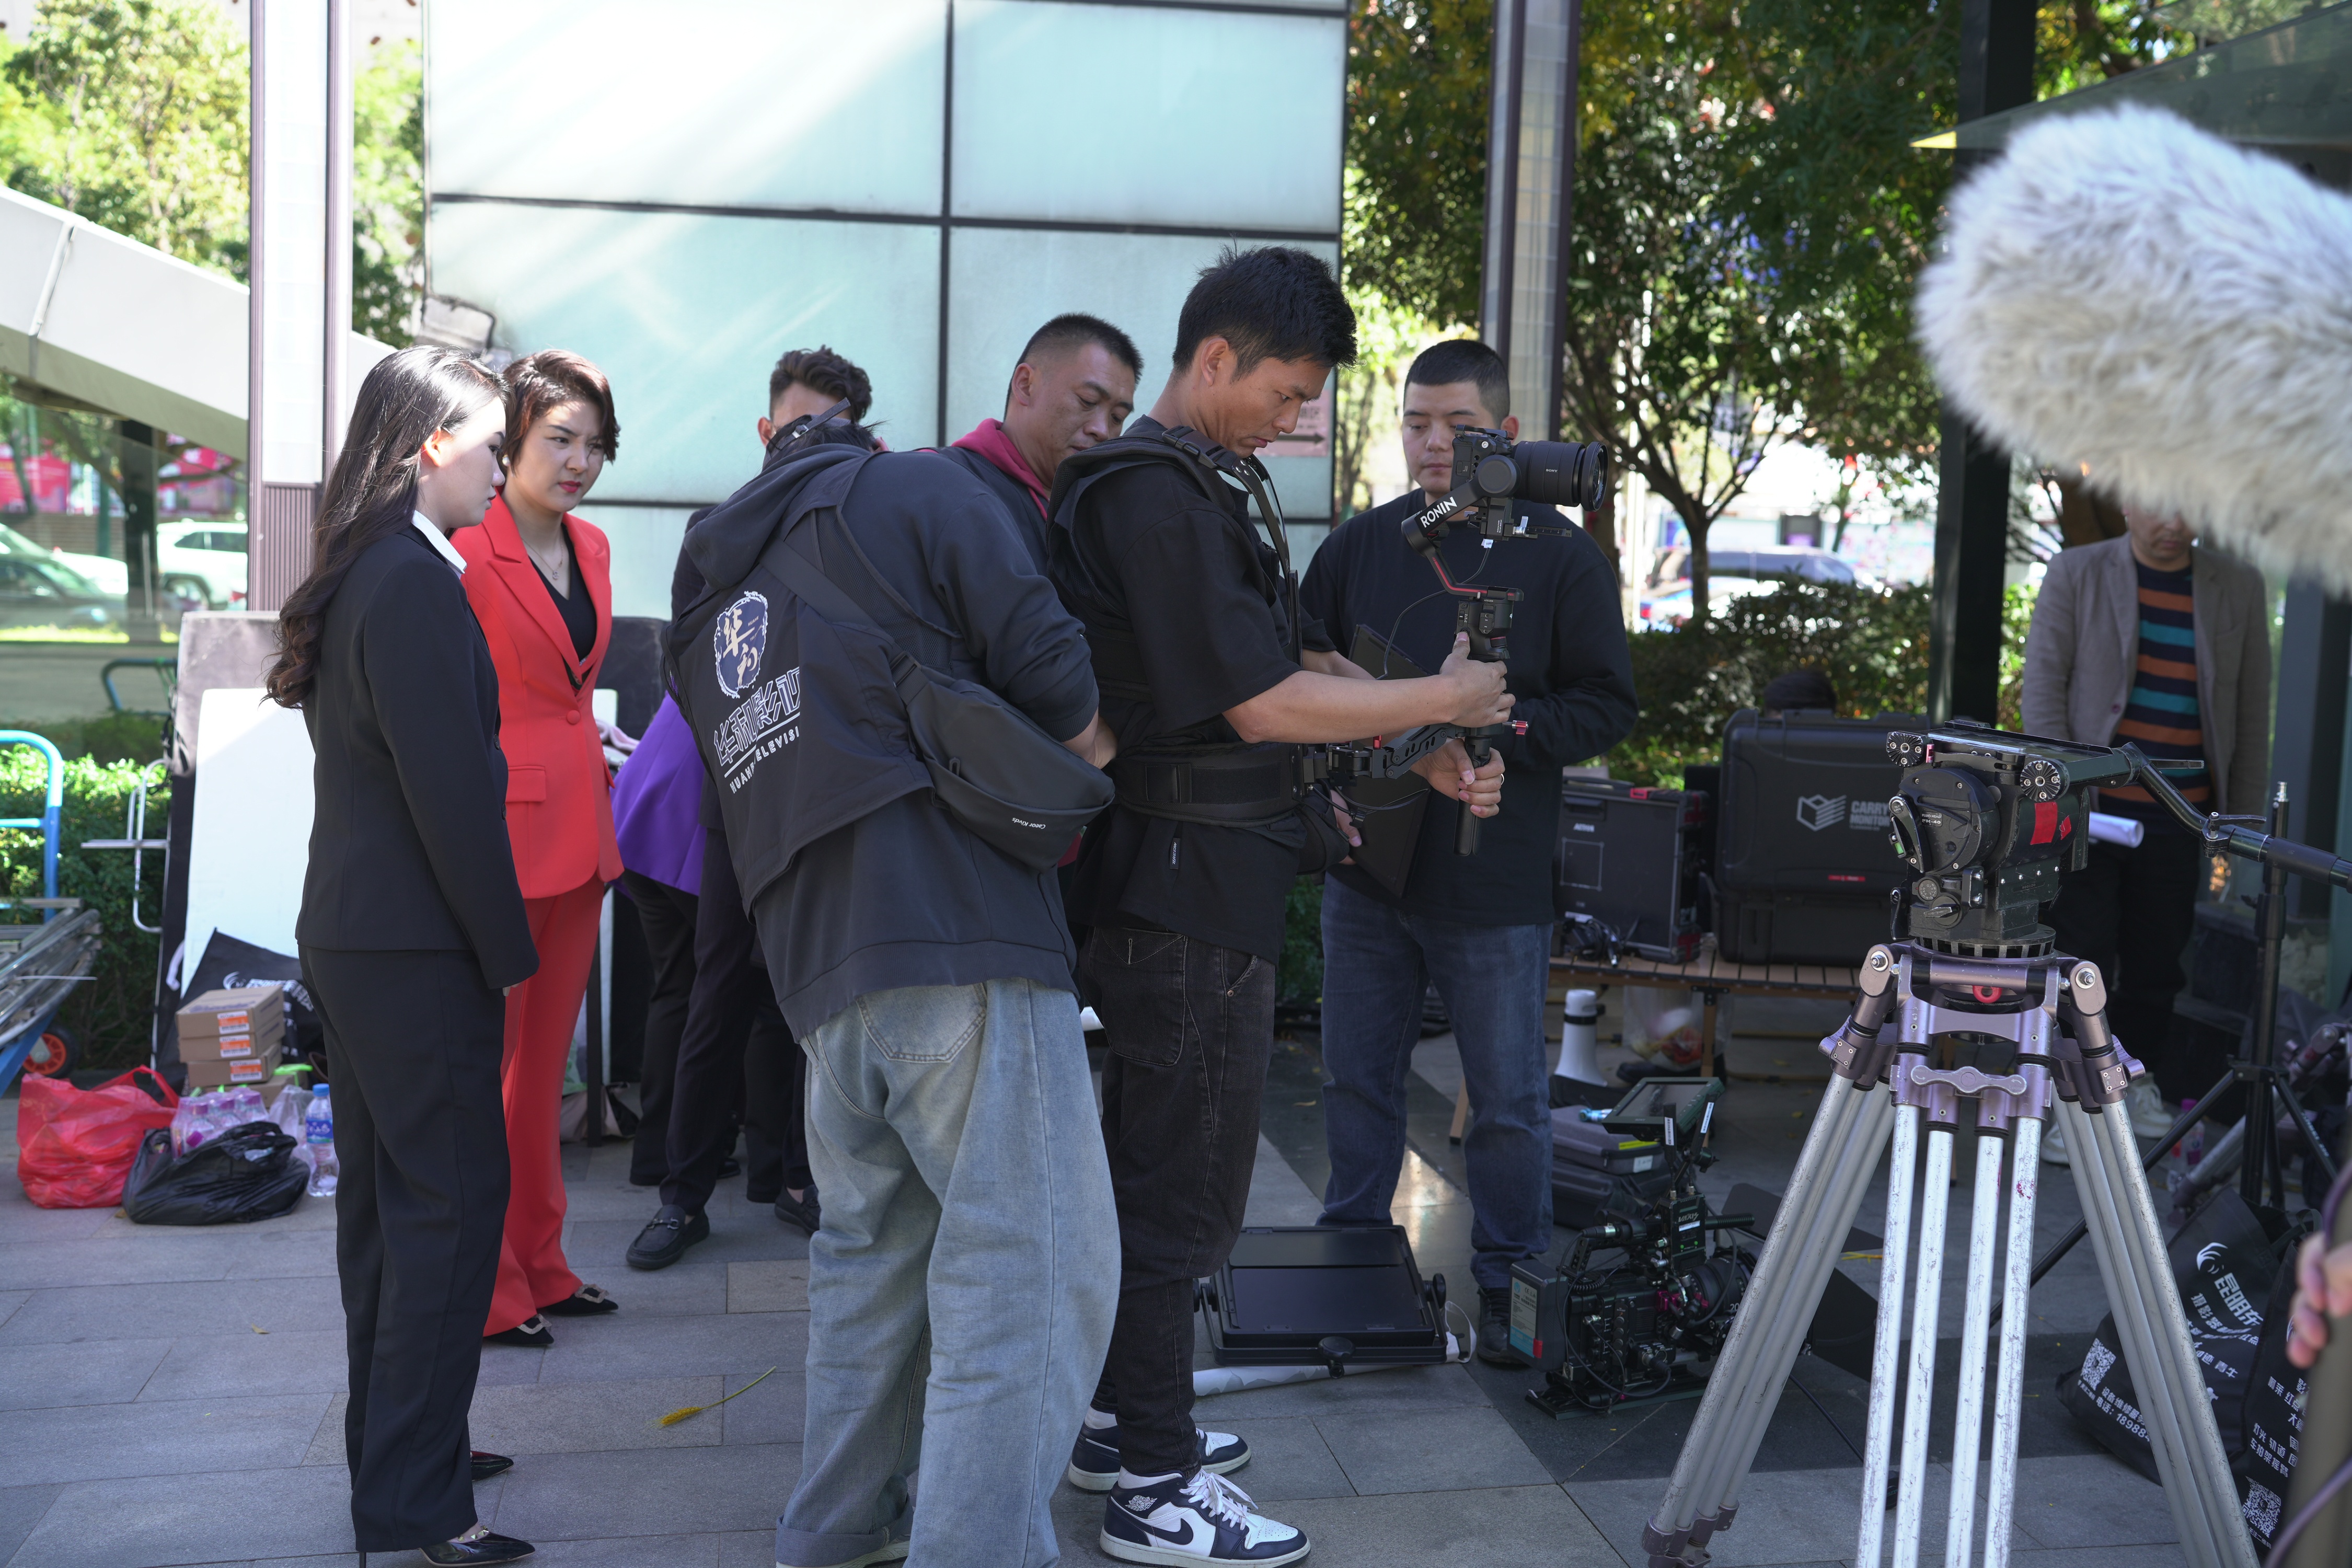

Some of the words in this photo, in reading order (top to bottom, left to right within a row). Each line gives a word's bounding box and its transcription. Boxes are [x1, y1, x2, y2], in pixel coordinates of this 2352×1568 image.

[1420, 497, 1458, 528] RONIN
[1852, 801, 1890, 816] CARRY
[1678, 1213, 1699, 1223] VAXIS
[2253, 1423, 2267, 1443] 灯光
[2269, 1437, 2286, 1458] 轨道
